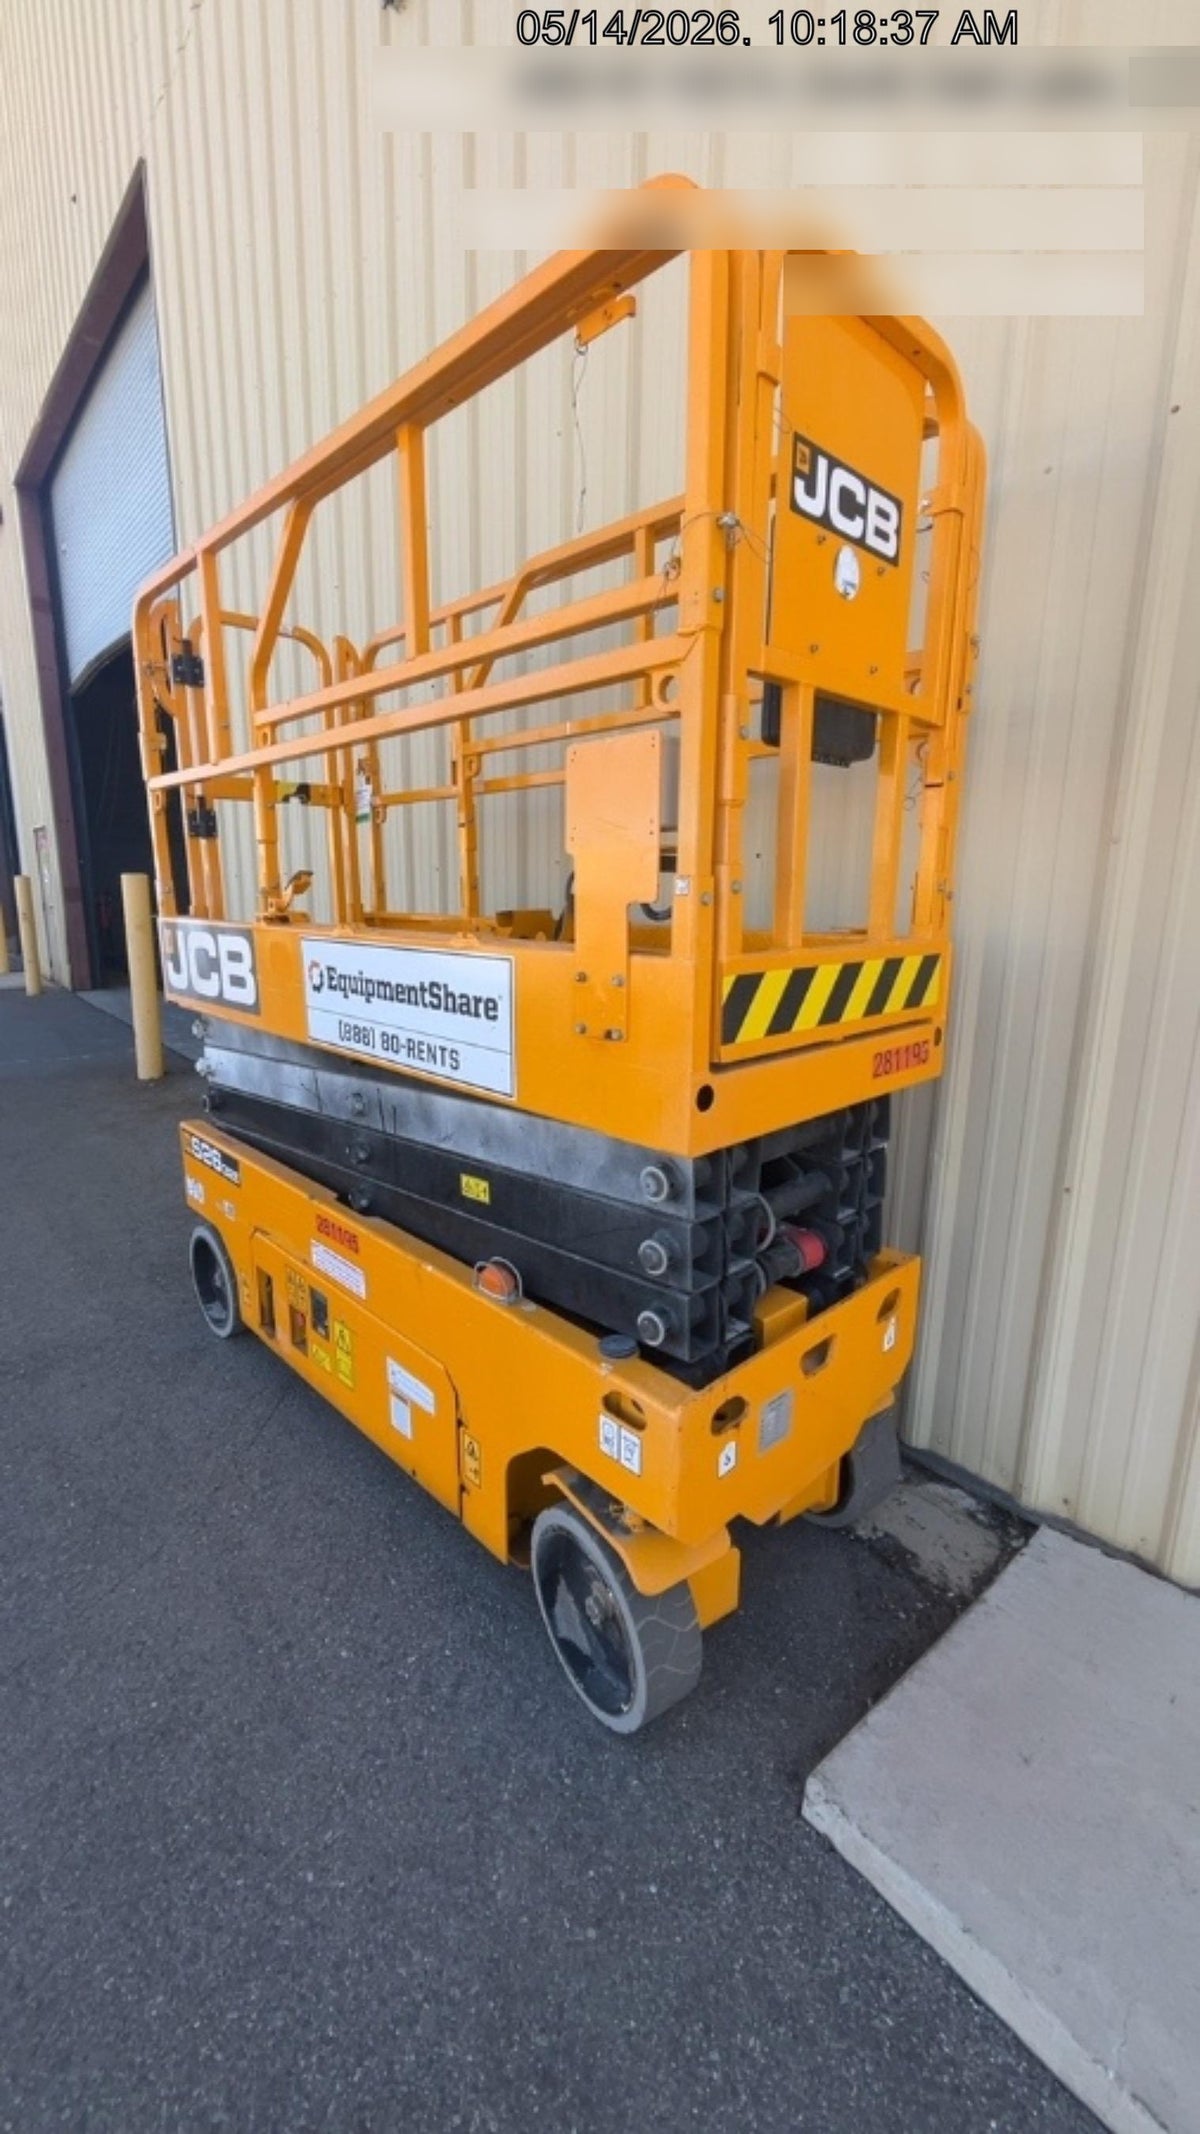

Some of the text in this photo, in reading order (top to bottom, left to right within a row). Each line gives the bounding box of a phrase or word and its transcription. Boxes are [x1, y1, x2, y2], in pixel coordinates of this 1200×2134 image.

[793, 454, 900, 559] JCB
[167, 929, 257, 1006] JCB
[326, 965, 499, 1021] EquipmentShare
[338, 1019, 461, 1070] (888) 80-RENTS
[873, 1040, 930, 1079] 281195
